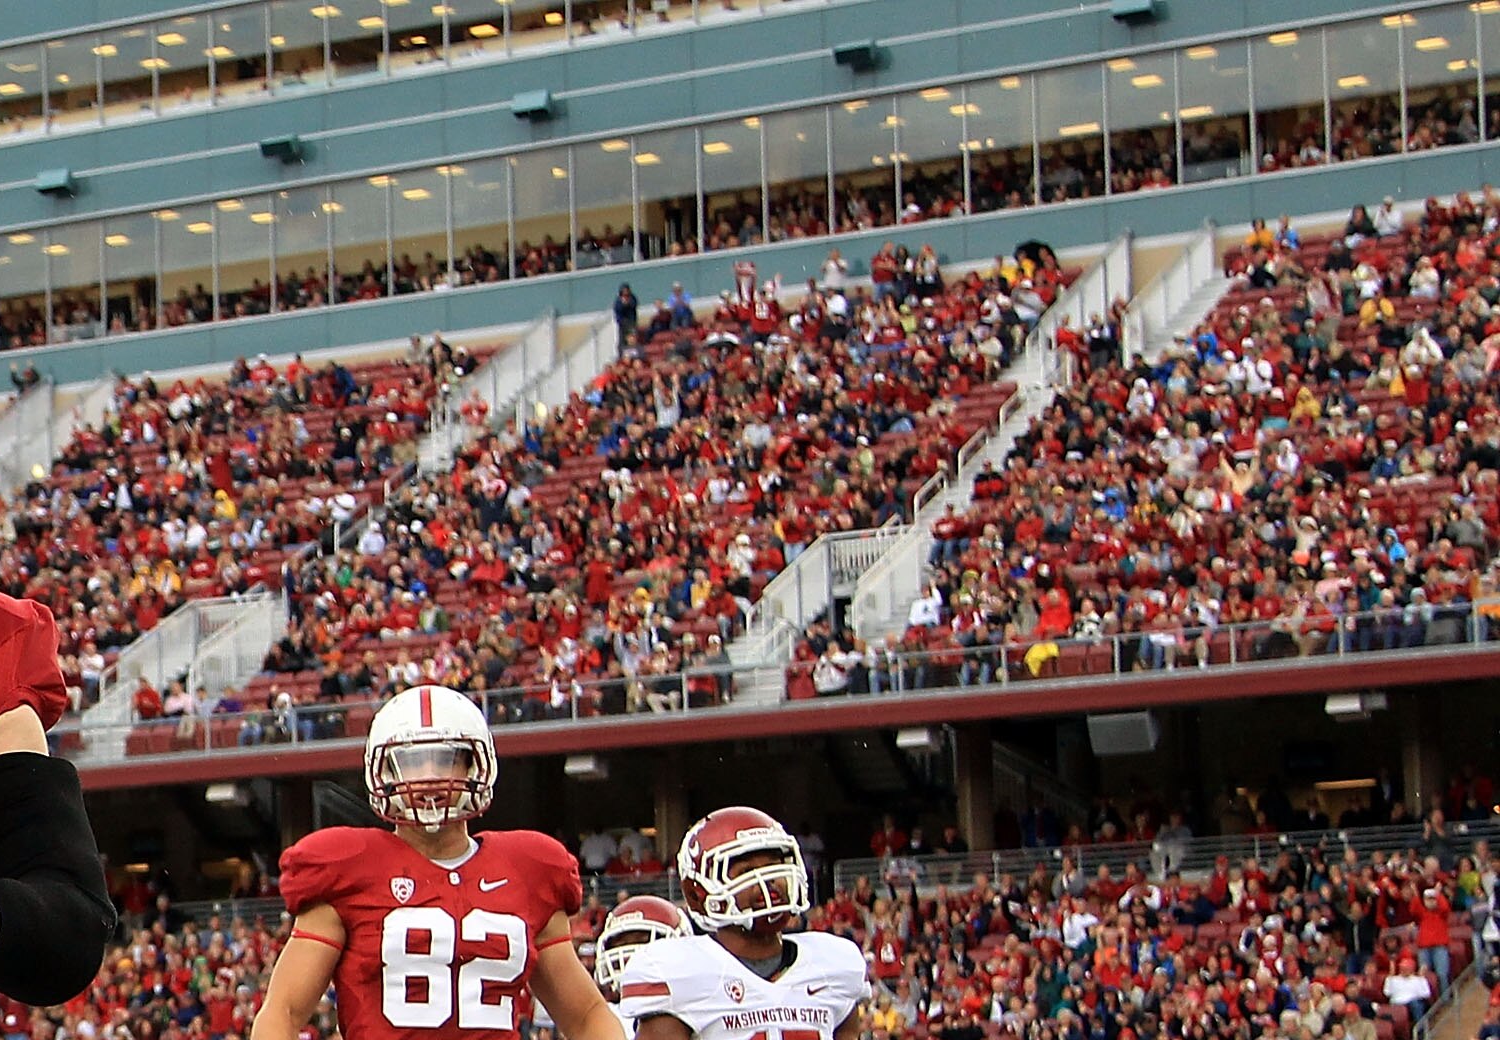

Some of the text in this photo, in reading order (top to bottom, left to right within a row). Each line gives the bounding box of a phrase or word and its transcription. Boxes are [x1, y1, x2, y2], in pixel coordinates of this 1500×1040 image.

[382, 907, 528, 1030] 82
[722, 1007, 829, 1030] WASHINGTON STATE
